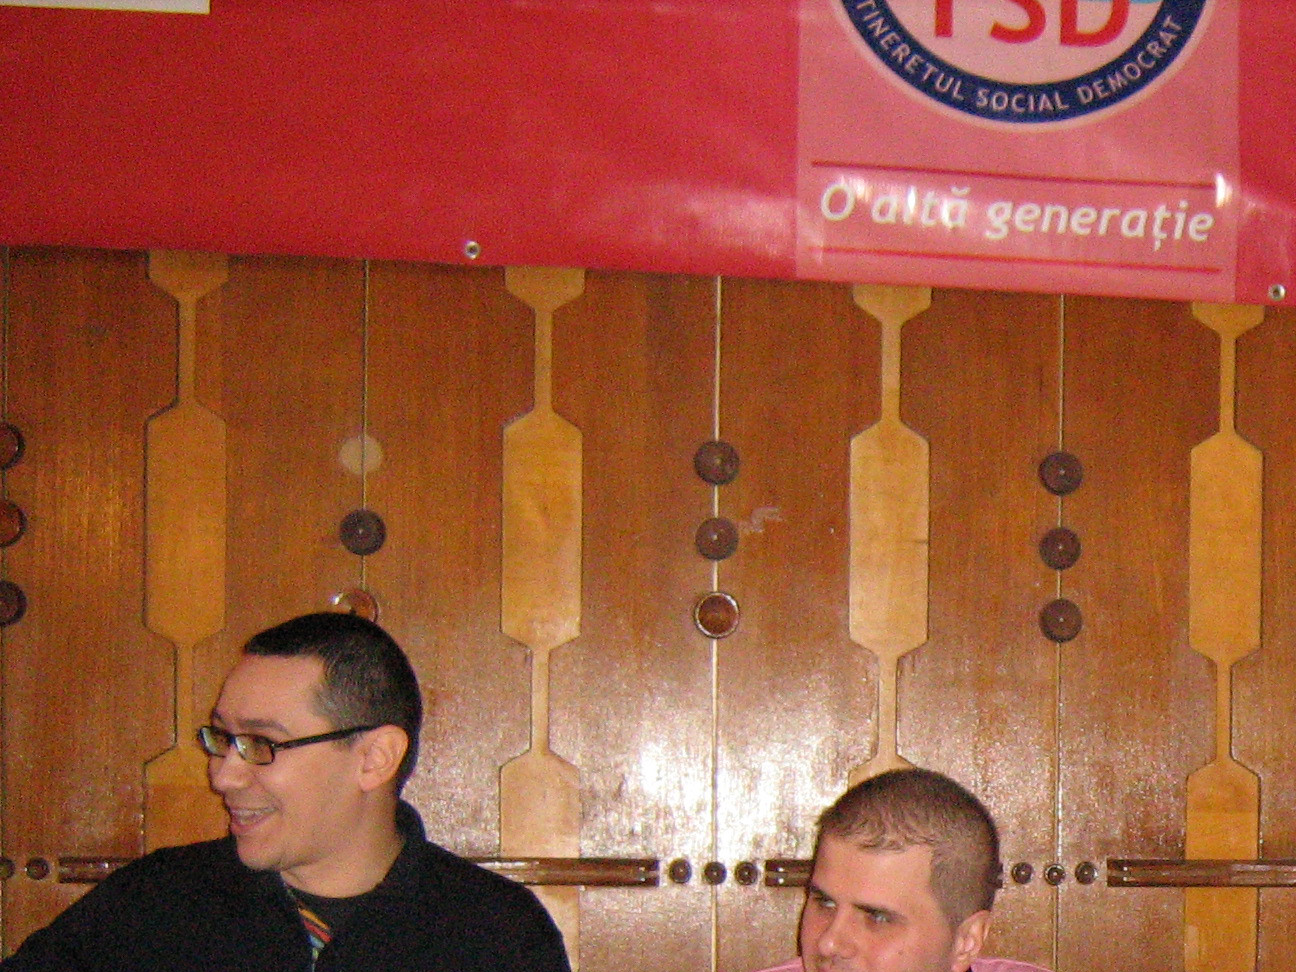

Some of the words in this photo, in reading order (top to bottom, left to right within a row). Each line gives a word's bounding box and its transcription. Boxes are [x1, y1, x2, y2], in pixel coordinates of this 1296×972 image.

[855, 1, 965, 102] TINERETUL
[975, 87, 1070, 114] SOCIAL
[1076, 15, 1184, 104] DEMOCRAT
[820, 181, 857, 222] O
[870, 185, 971, 230] altă
